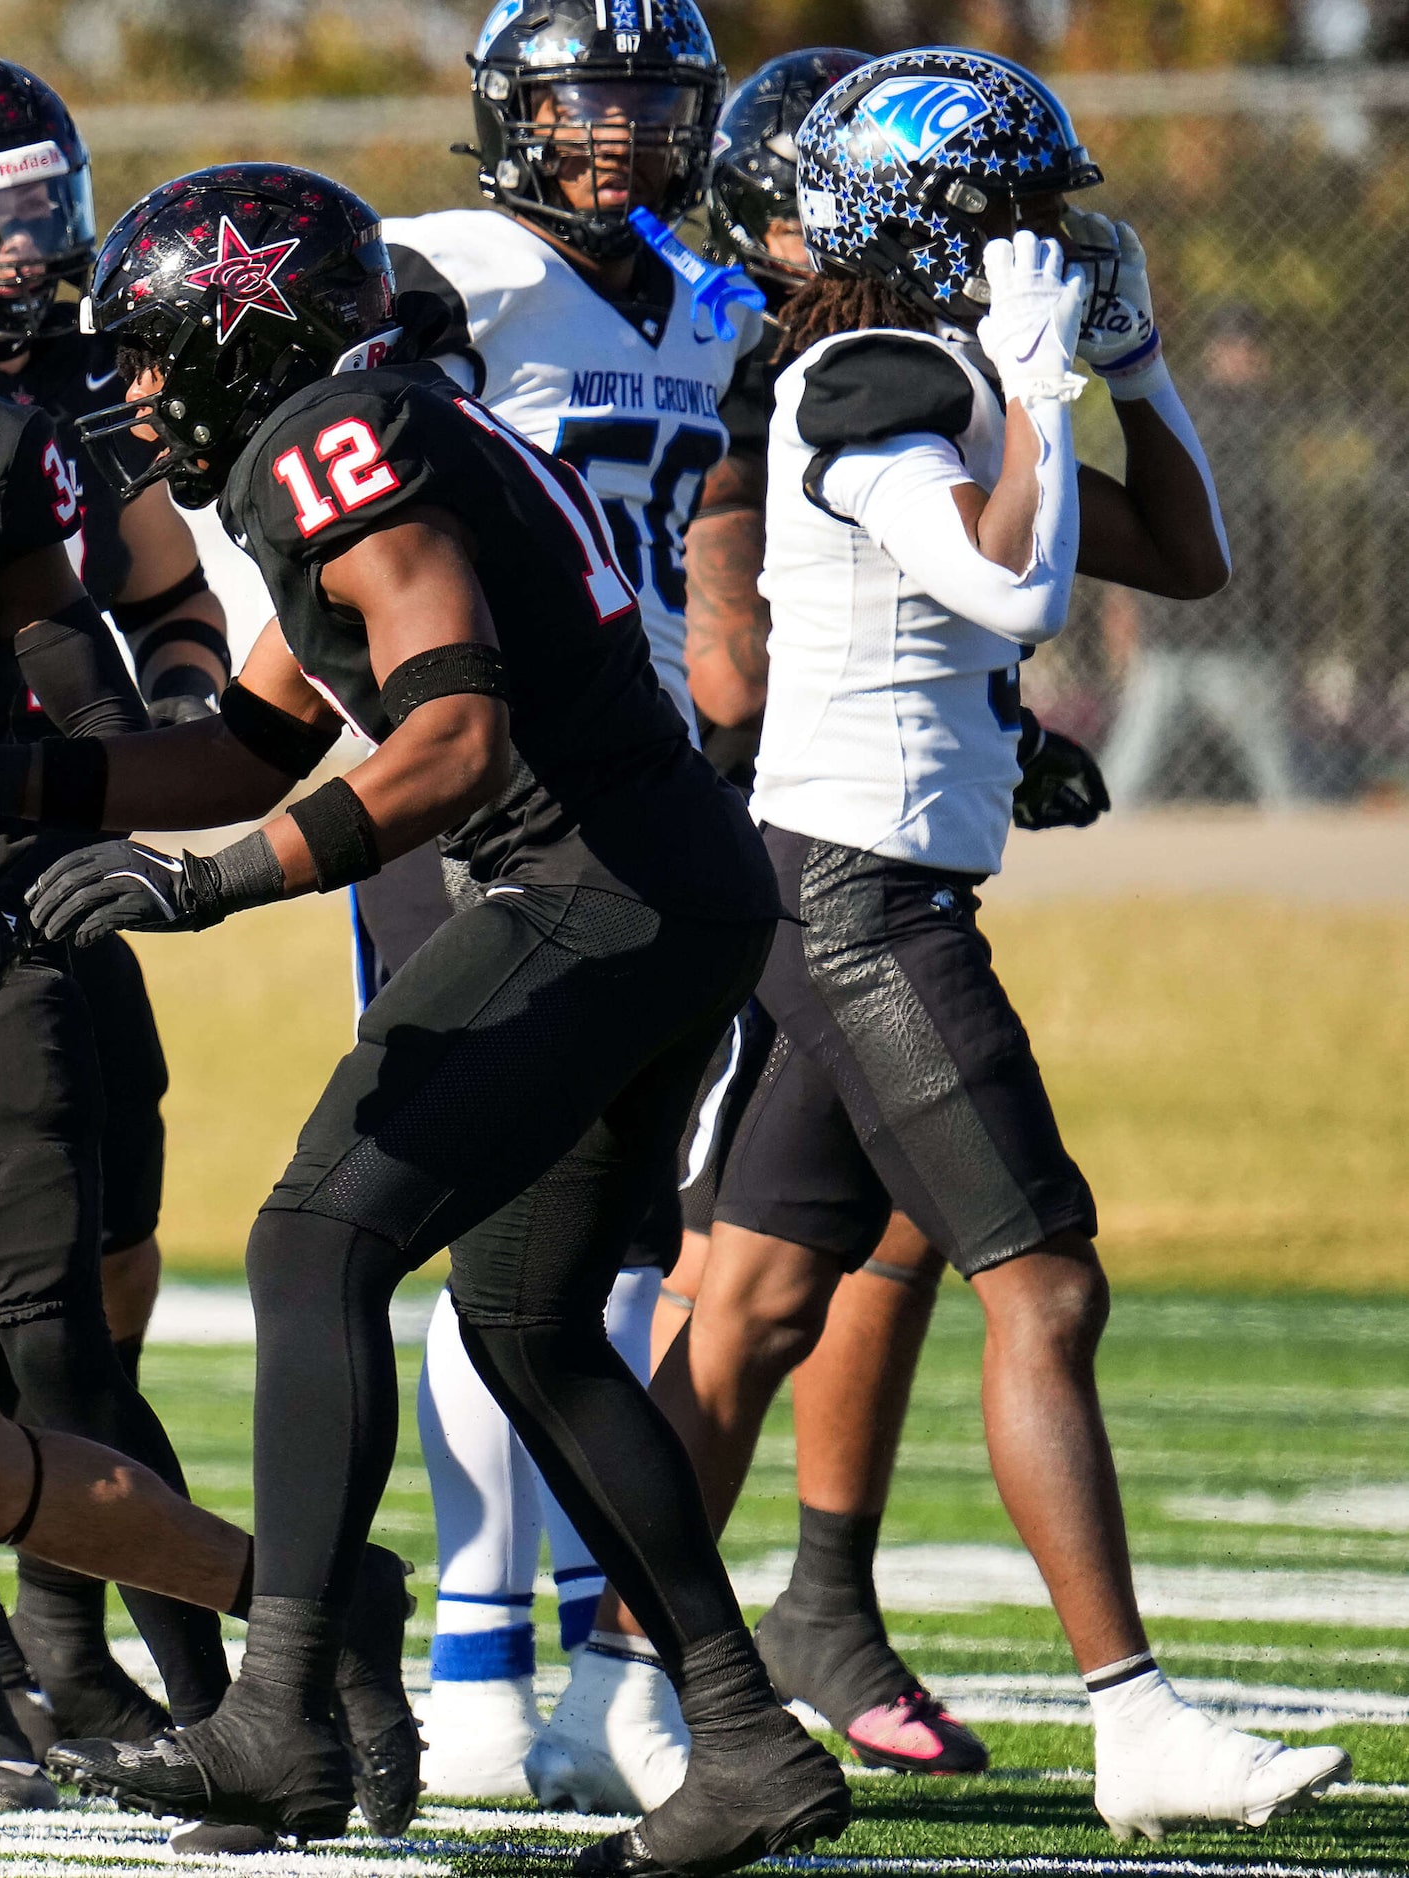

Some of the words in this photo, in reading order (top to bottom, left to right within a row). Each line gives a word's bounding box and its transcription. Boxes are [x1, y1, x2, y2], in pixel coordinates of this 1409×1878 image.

[616, 33, 640, 53] 817
[569, 370, 644, 408] NORTH
[272, 415, 402, 539] 12
